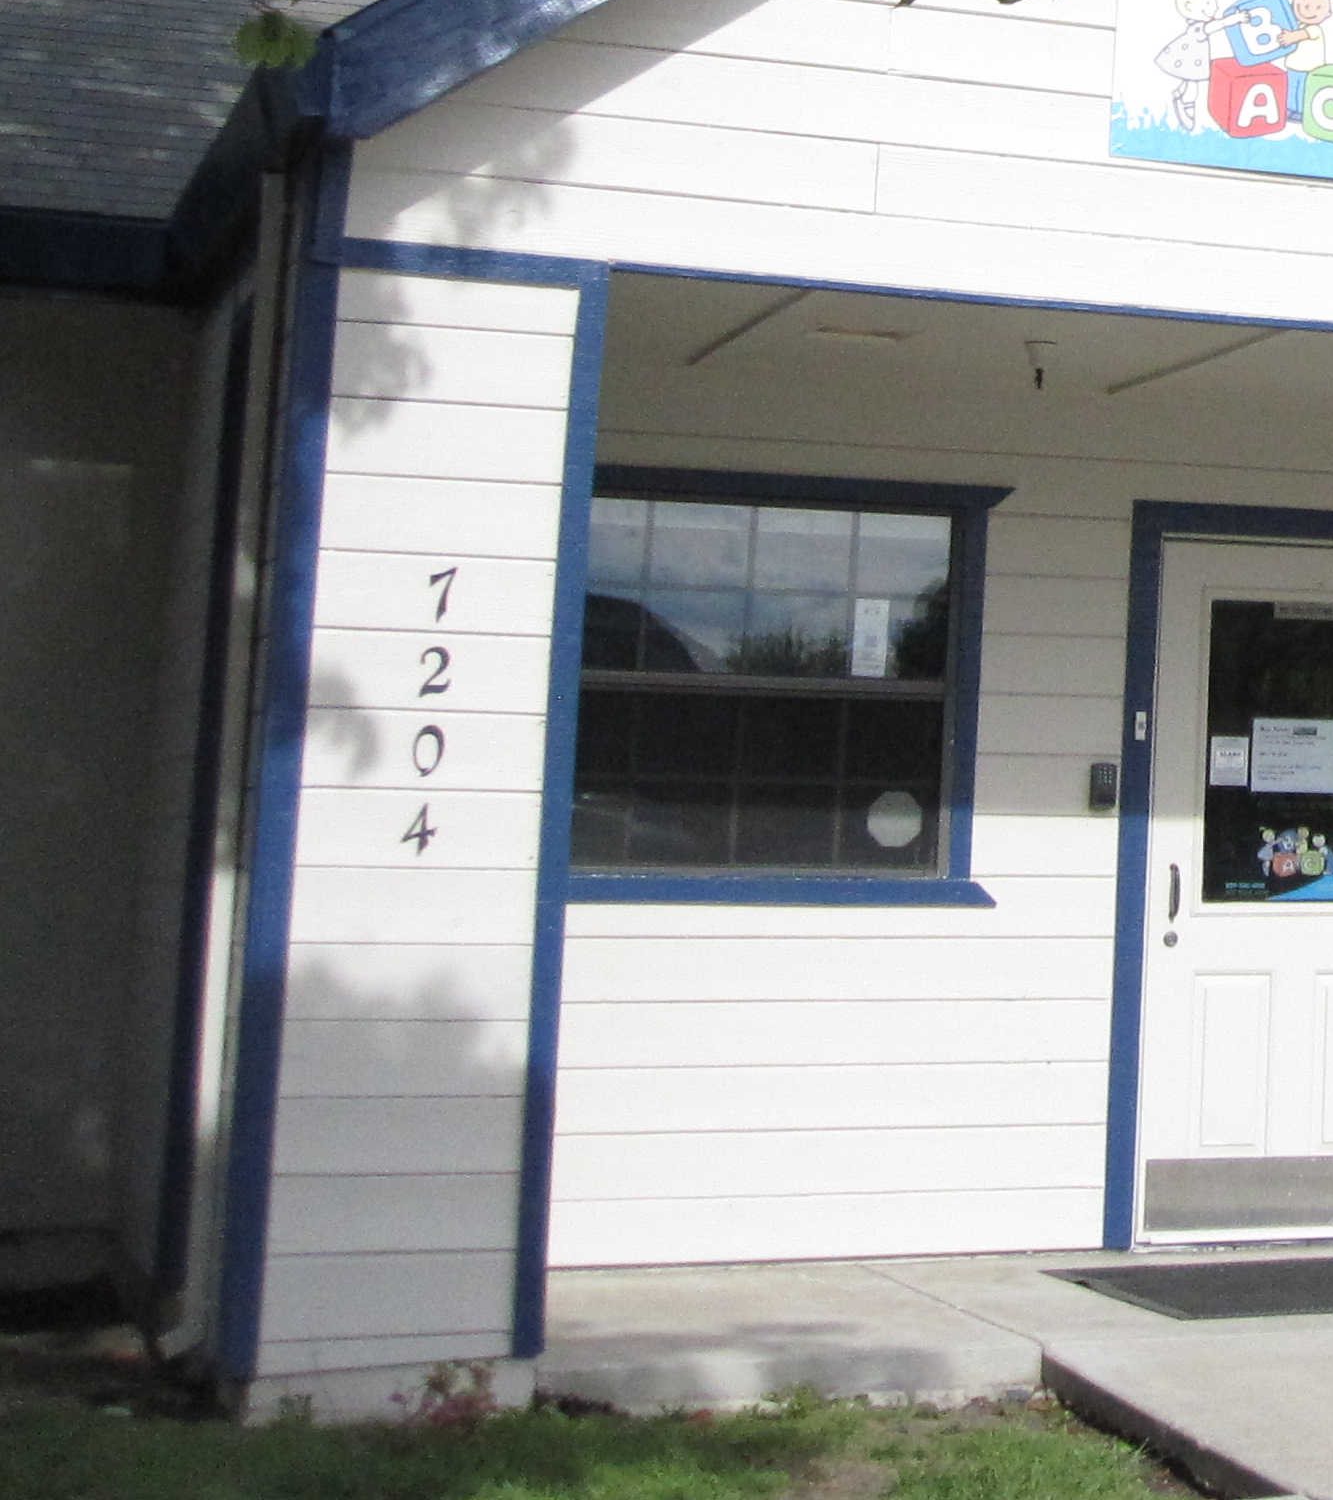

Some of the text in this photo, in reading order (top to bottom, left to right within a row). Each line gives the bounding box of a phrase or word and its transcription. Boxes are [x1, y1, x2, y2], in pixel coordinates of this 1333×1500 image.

[1240, 6, 1283, 56] B
[1236, 83, 1281, 128] A
[401, 566, 457, 855] 7204
